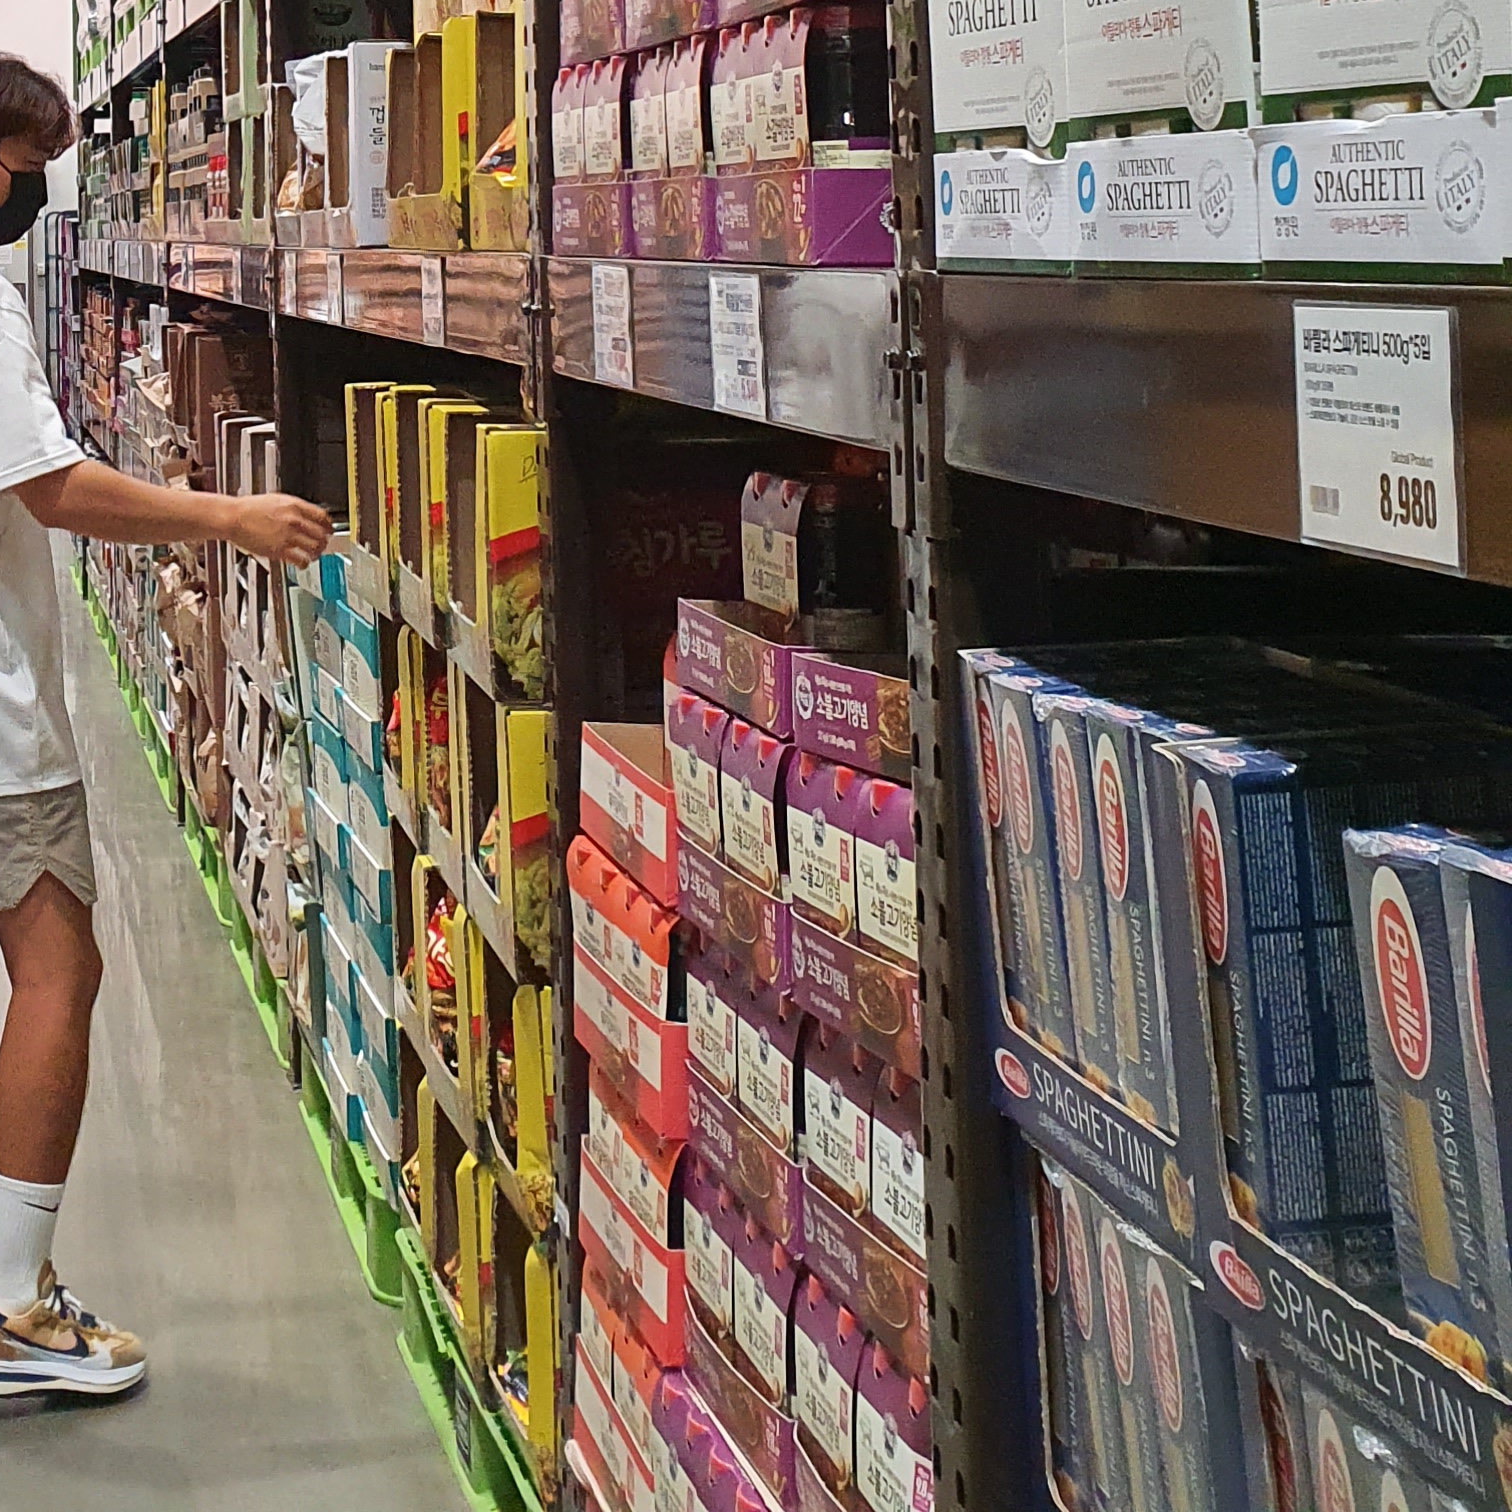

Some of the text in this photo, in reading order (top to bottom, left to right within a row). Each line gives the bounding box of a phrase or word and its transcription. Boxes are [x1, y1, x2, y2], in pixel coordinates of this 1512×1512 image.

[1438, 34, 1474, 77] ITALY
[1191, 65, 1216, 102] ITALY
[966, 167, 1009, 185] AUTHENTIC
[1118, 157, 1175, 178] AUTHENTIC
[1330, 140, 1405, 164] AUTHENTIC
[959, 188, 1021, 215] SPAGHETTI
[1107, 180, 1192, 212] SPAGHETTI
[1314, 167, 1425, 203] SPAGHETTI
[1443, 170, 1476, 209] ITALY
[1303, 328, 1331, 354] 바릴라
[1333, 330, 1380, 357] 스파게티니
[1380, 473, 1437, 529] 8,980
[816, 691, 868, 729] 소불고기양념
[1007, 737, 1030, 847] Barilla
[1058, 758, 1080, 875] Barilla
[1102, 772, 1122, 894] Barilla
[800, 859, 840, 903] 소불고기양념
[1200, 821, 1225, 953] Barilla
[1129, 905, 1152, 1043] SPAGHETTINI
[1384, 911, 1423, 1062] Barilla
[1229, 970, 1252, 1121] SPAGHETTINI
[1032, 1063, 1157, 1190] SPAGHETTINI
[1435, 1087, 1474, 1260] SPAGHETTINI
[884, 1182, 924, 1236] 소불고기양
[1269, 1268, 1481, 1462] SPAGHETTINI
